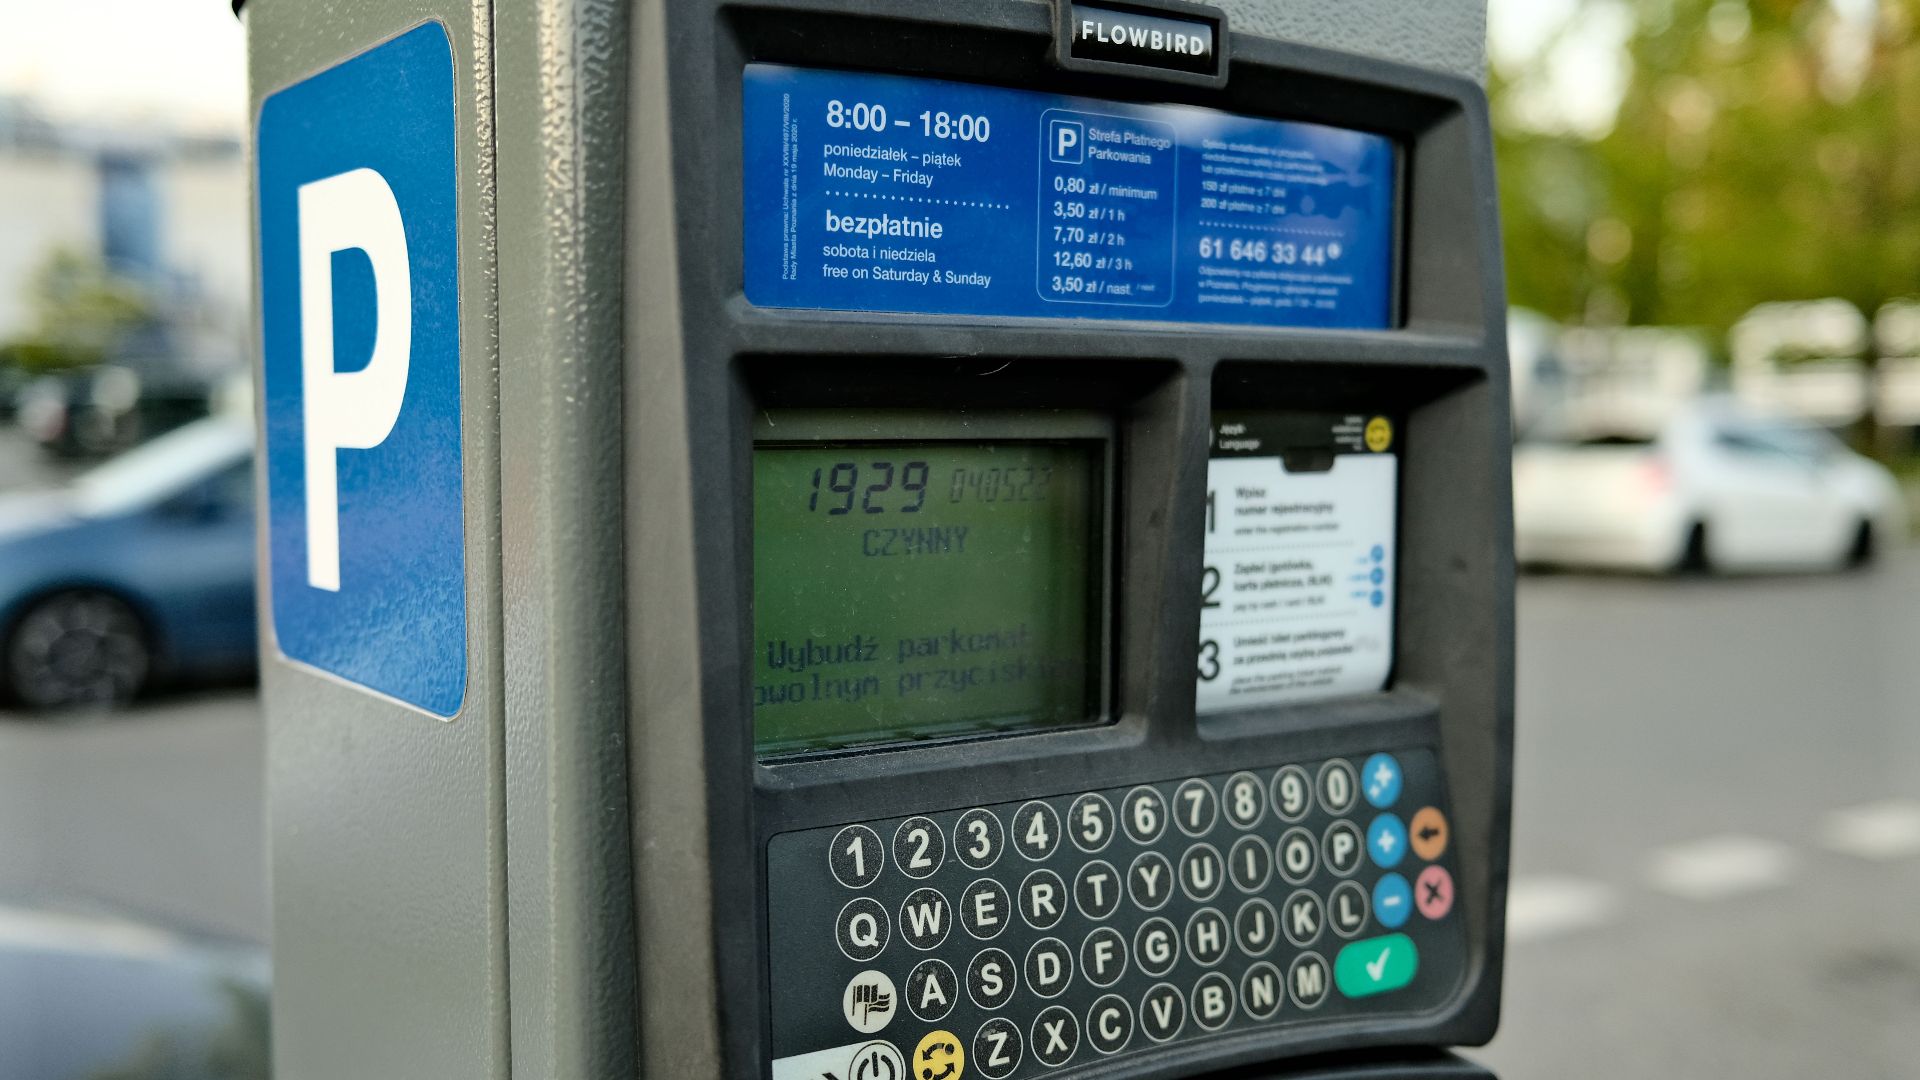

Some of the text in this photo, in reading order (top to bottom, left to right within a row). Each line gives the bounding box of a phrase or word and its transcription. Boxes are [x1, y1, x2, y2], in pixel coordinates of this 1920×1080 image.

[1081, 19, 1205, 56] FLOWBIRD
[790, 124, 798, 142] 2020
[826, 99, 887, 133] 8:00
[918, 110, 990, 143] 18:00
[1058, 128, 1077, 156] P
[1088, 128, 1171, 150] Strefa Płatnego
[823, 143, 908, 163] poniedziałek
[922, 151, 962, 168] piątek
[1088, 146, 1152, 165] Parkowania
[790, 175, 798, 191] dnia
[823, 162, 878, 183] Monday
[893, 168, 934, 187] Friday
[1054, 176, 1085, 195] 0,80
[1089, 184, 1100, 195] zł
[1108, 186, 1158, 201] minimum
[1203, 180, 1218, 193] 150
[790, 199, 798, 233] Poznania
[1053, 201, 1085, 220] 3,50
[1088, 208, 1099, 220] zł
[1108, 209, 1115, 221] 1
[1117, 209, 1126, 222] h
[1201, 196, 1217, 209] 200
[826, 209, 943, 239] bezpłatnie
[1053, 226, 1084, 245] 7,70
[1088, 233, 1099, 245] zł
[1107, 233, 1115, 246] 2
[1116, 234, 1126, 247] h
[782, 243, 790, 279] Podstawa
[823, 245, 936, 263] sobota i niedziela
[1053, 252, 1092, 270] 12,60
[1095, 258, 1106, 270] zł
[1115, 259, 1123, 271] 3
[1124, 260, 1133, 272] h
[1200, 237, 1326, 266] 61 646 33 44
[790, 260, 798, 279] Rady
[823, 264, 992, 287] free on Saturday & Sunday
[1052, 276, 1083, 294] 3,50
[1085, 281, 1097, 293] zł
[1106, 284, 1133, 296] nast.
[298, 166, 413, 592] P
[809, 461, 929, 515] 1929
[1206, 490, 1215, 533] 1
[862, 526, 969, 557] CZYNNY
[1201, 566, 1220, 608] 2
[767, 634, 880, 673] Wybudź
[1199, 639, 1220, 681] 3
[846, 769, 1348, 877] 1 2 3 4 5 6 7 8 9 0
[849, 832, 1353, 947] Q W E R T Y U I O P
[920, 895, 1359, 1009] A S D F G H J K L
[986, 963, 1322, 1067] Z X C V B N M
